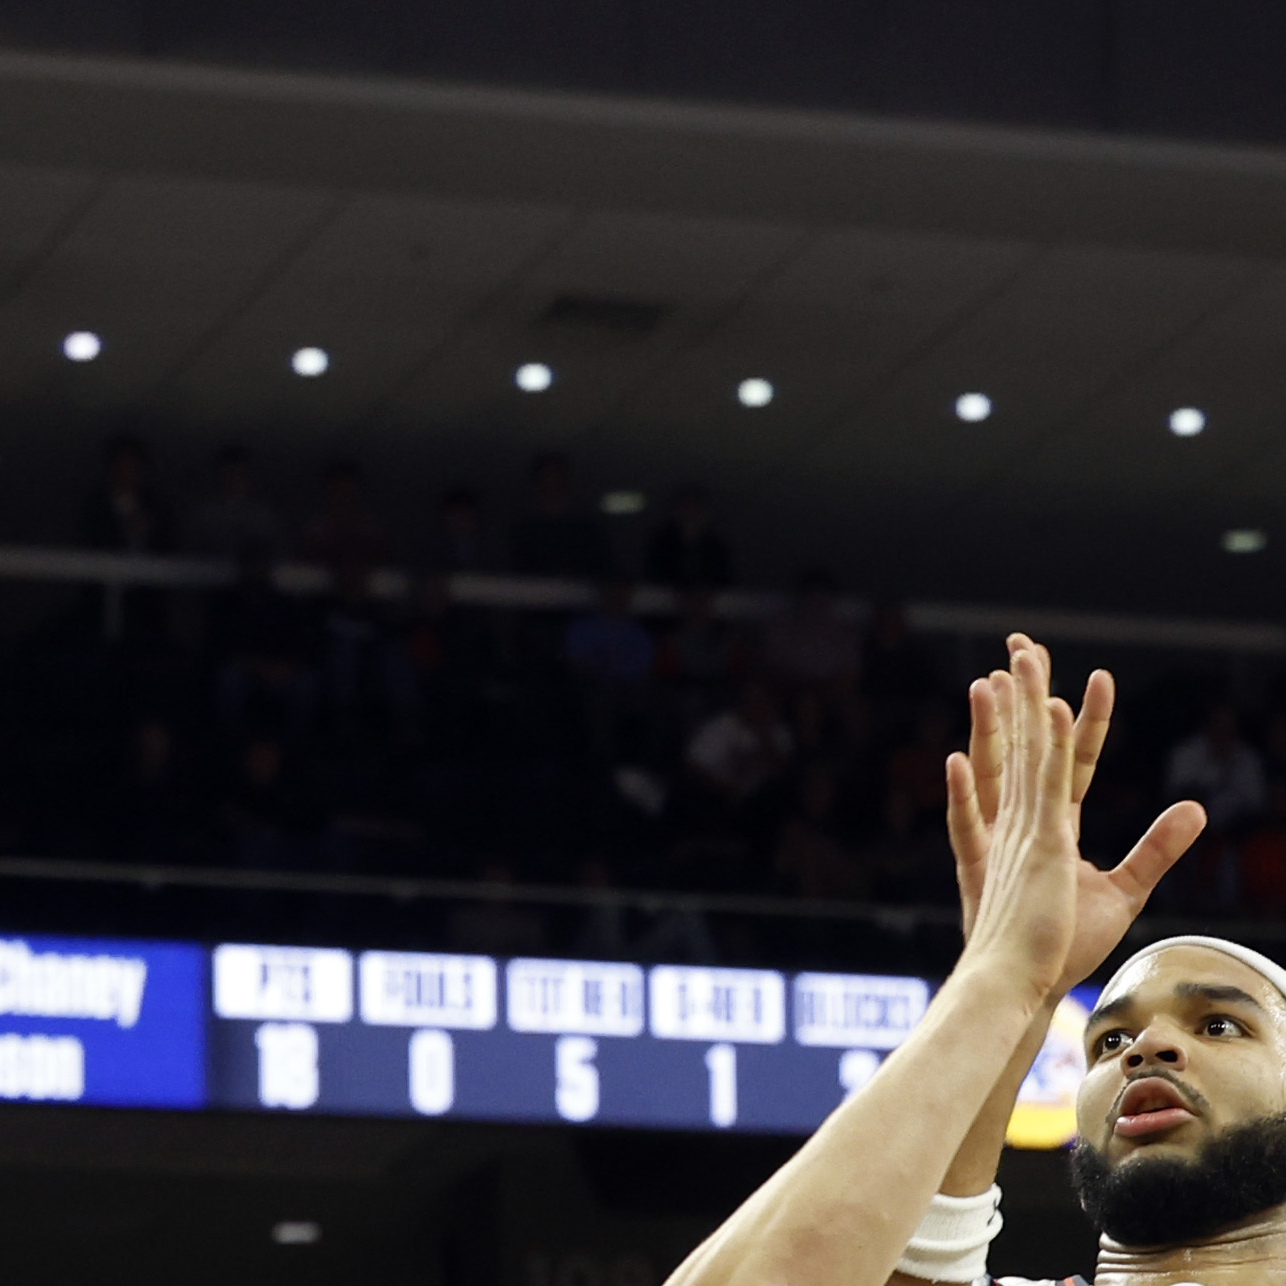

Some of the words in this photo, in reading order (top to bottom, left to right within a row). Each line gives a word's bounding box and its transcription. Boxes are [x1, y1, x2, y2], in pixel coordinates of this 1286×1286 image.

[411, 1029, 453, 1114] 0
[555, 1036, 599, 1120] 5
[706, 1043, 737, 1126] 1
